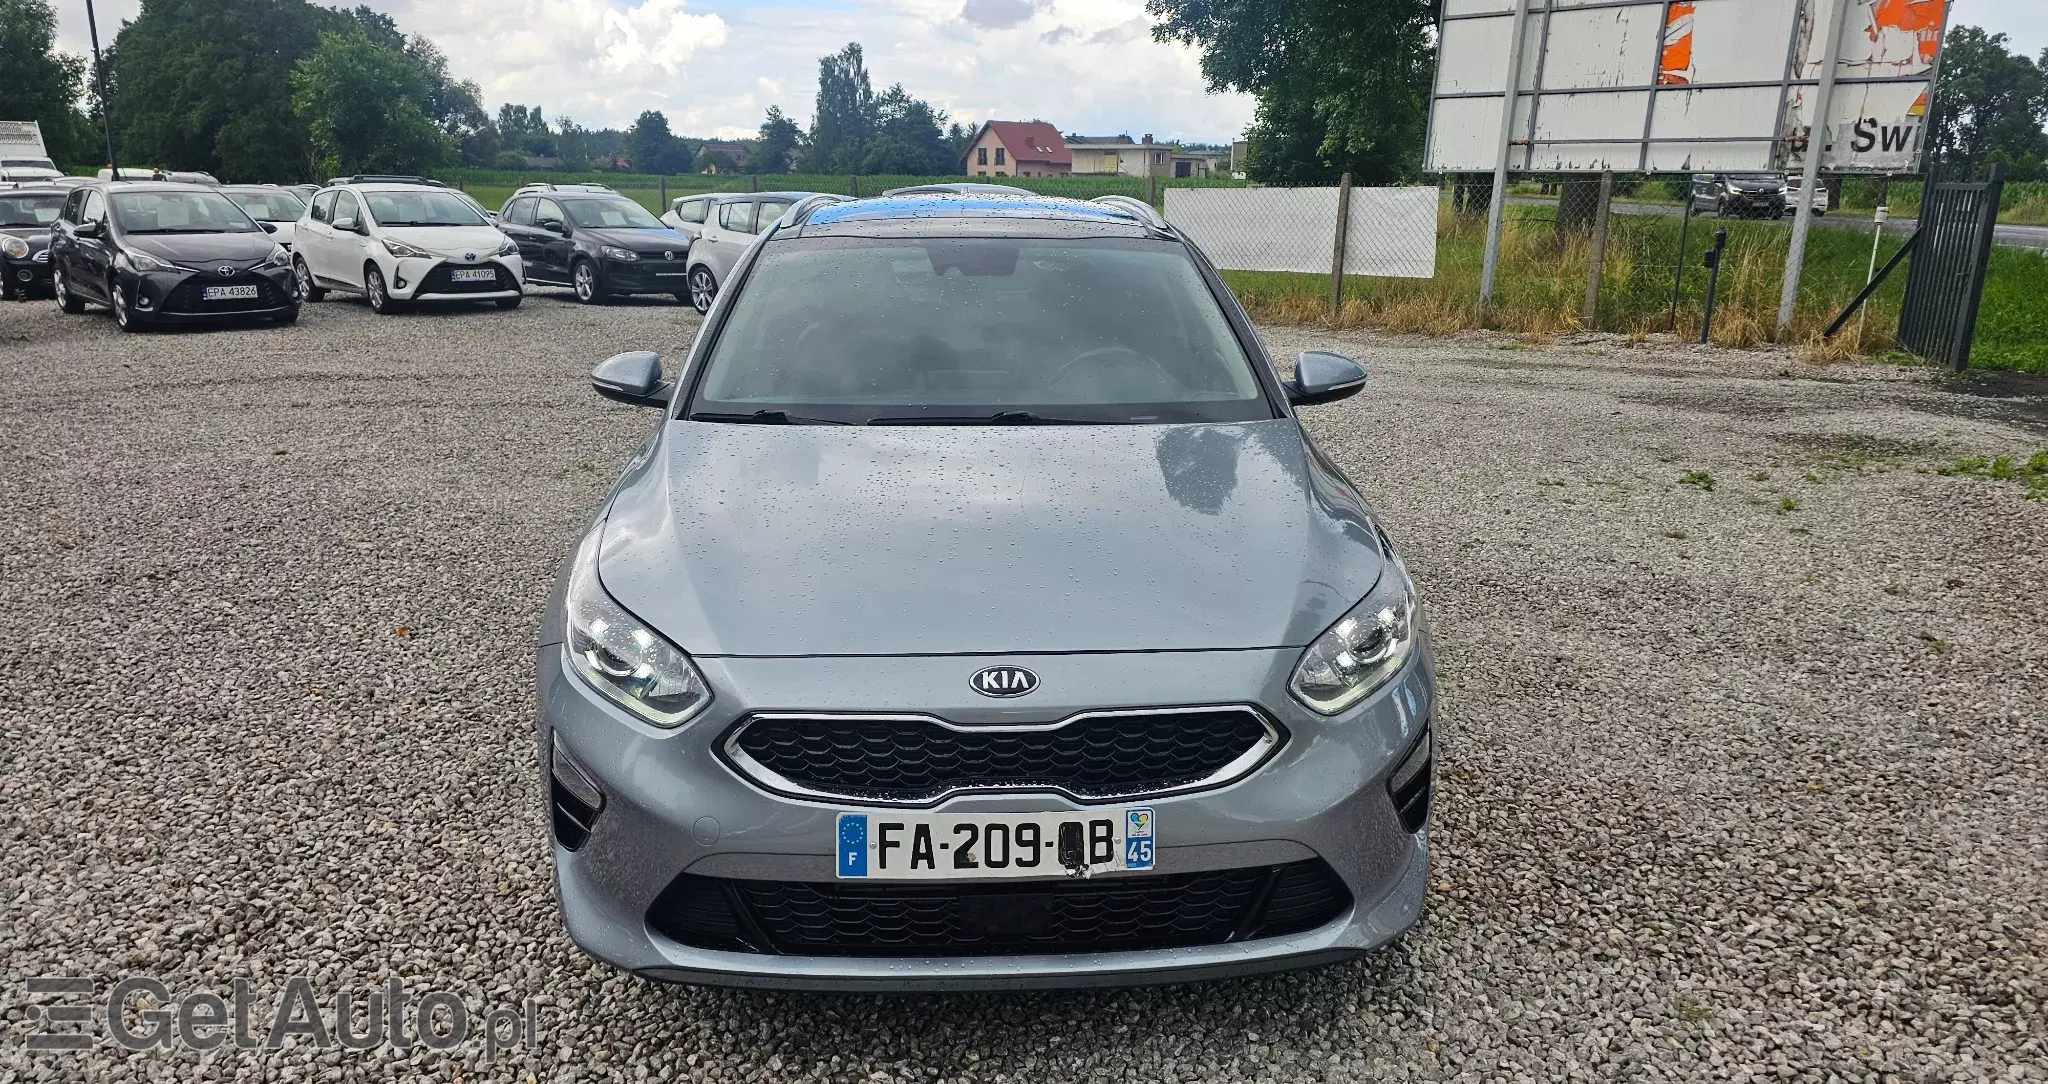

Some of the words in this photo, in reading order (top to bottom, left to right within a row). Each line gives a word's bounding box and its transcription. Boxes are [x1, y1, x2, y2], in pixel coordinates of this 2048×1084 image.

[455, 270, 471, 280] EPA
[472, 270, 495, 279] 41095
[207, 287, 226, 297] EPA
[229, 286, 257, 296] 43826
[981, 670, 1030, 689] KIA
[1127, 840, 1152, 862] 45
[848, 852, 858, 866] F
